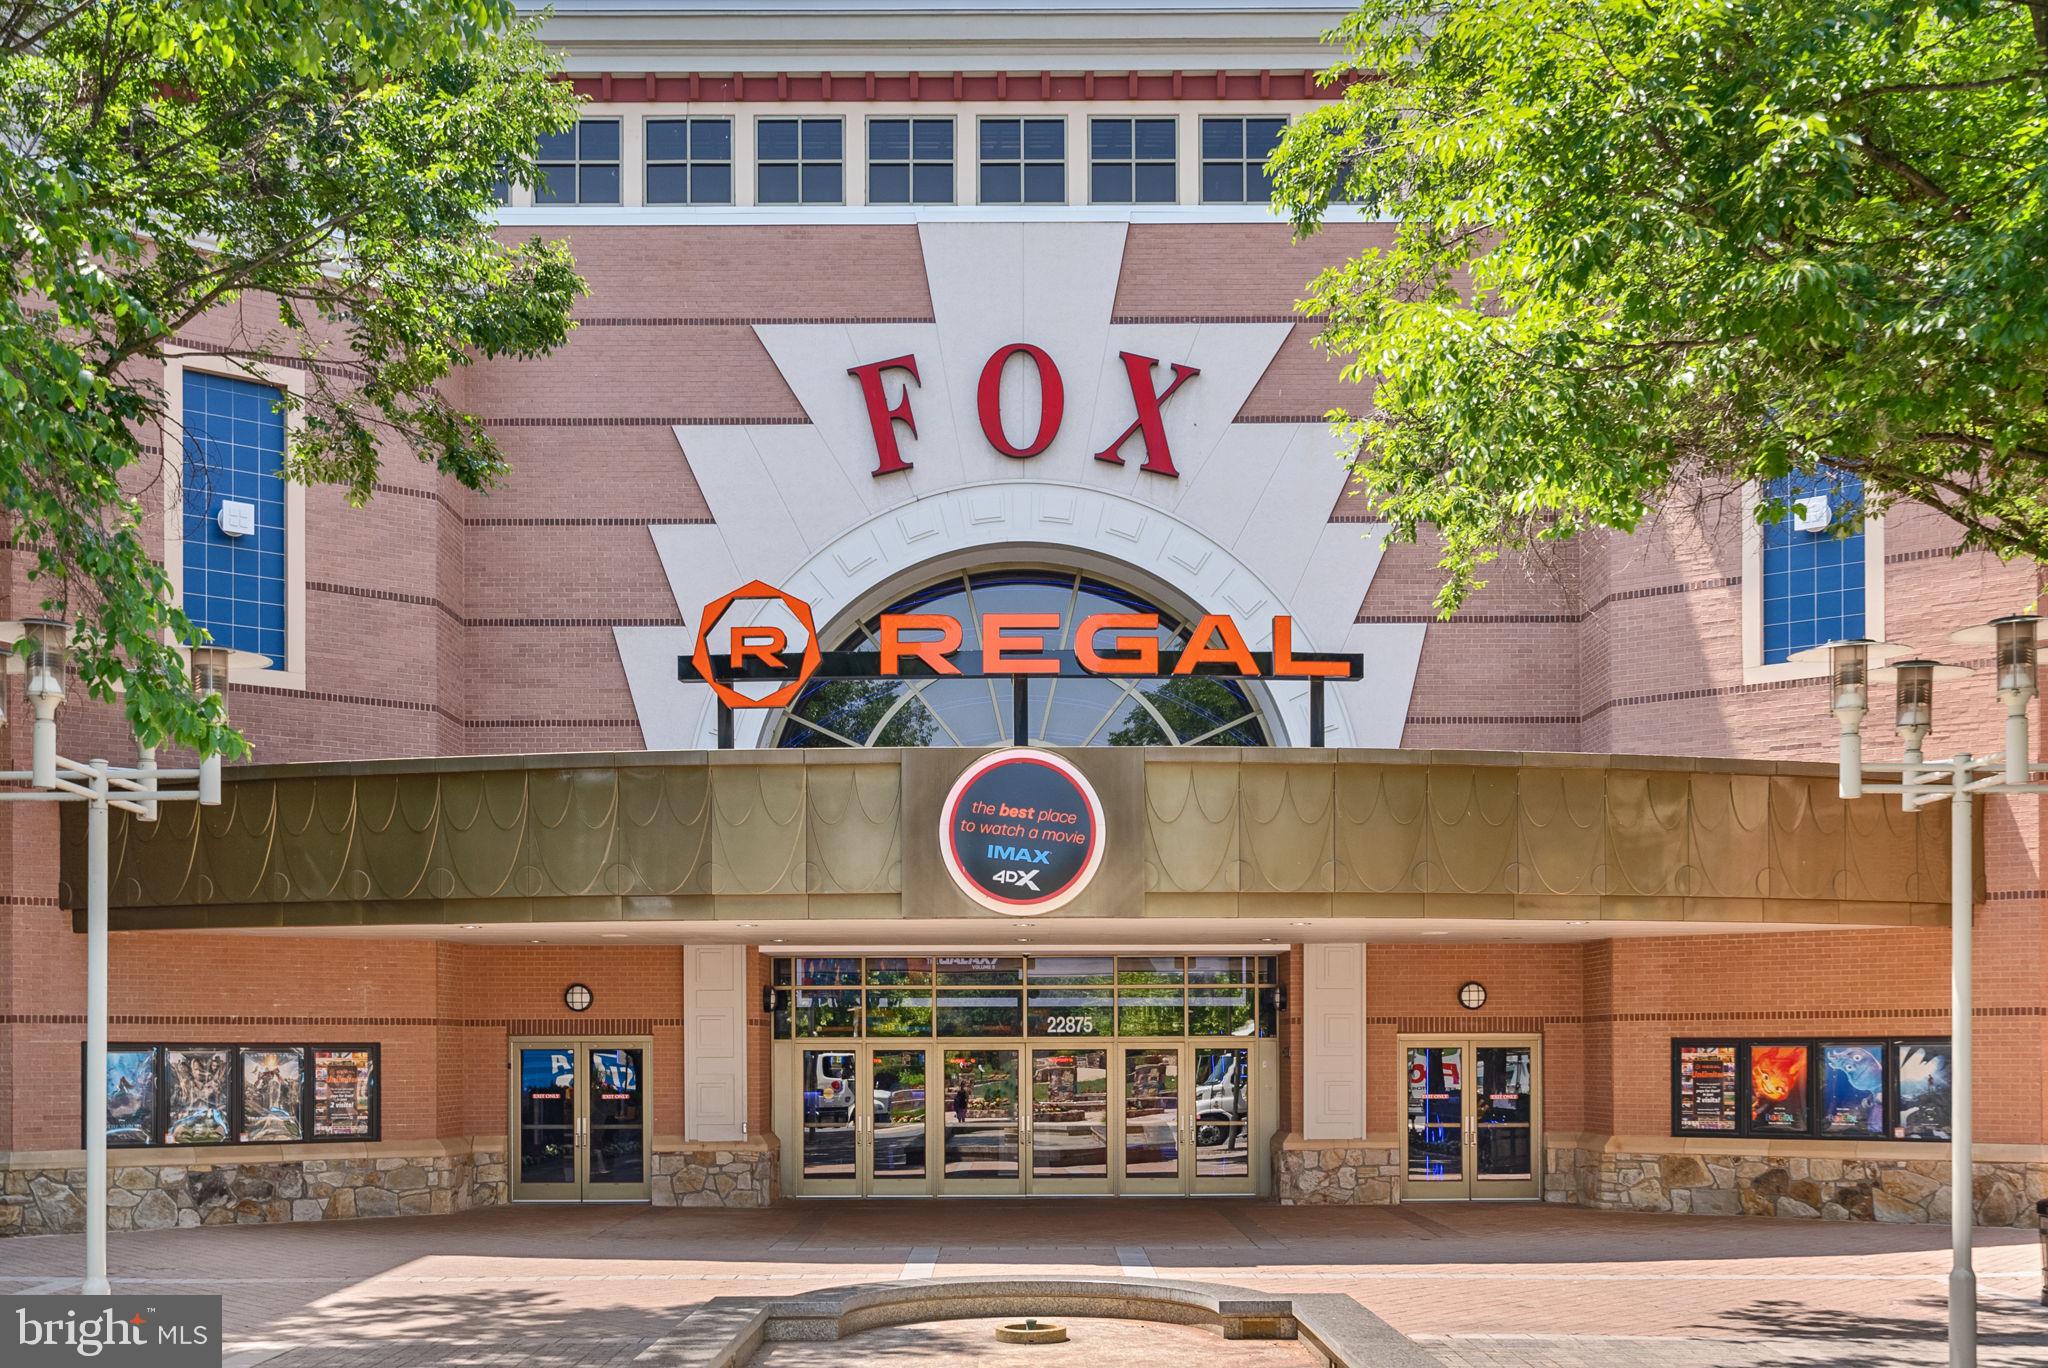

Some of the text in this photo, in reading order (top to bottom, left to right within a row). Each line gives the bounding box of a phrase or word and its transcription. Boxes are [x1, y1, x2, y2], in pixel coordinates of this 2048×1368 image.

[847, 342, 1200, 478] FOX
[730, 613, 1351, 677] R REGAL
[972, 801, 1077, 824] the best place
[960, 820, 1085, 844] to watch a movie
[987, 845, 1050, 864] IMAX
[992, 870, 1040, 891] 4DX
[1047, 1016, 1093, 1033] 22875
